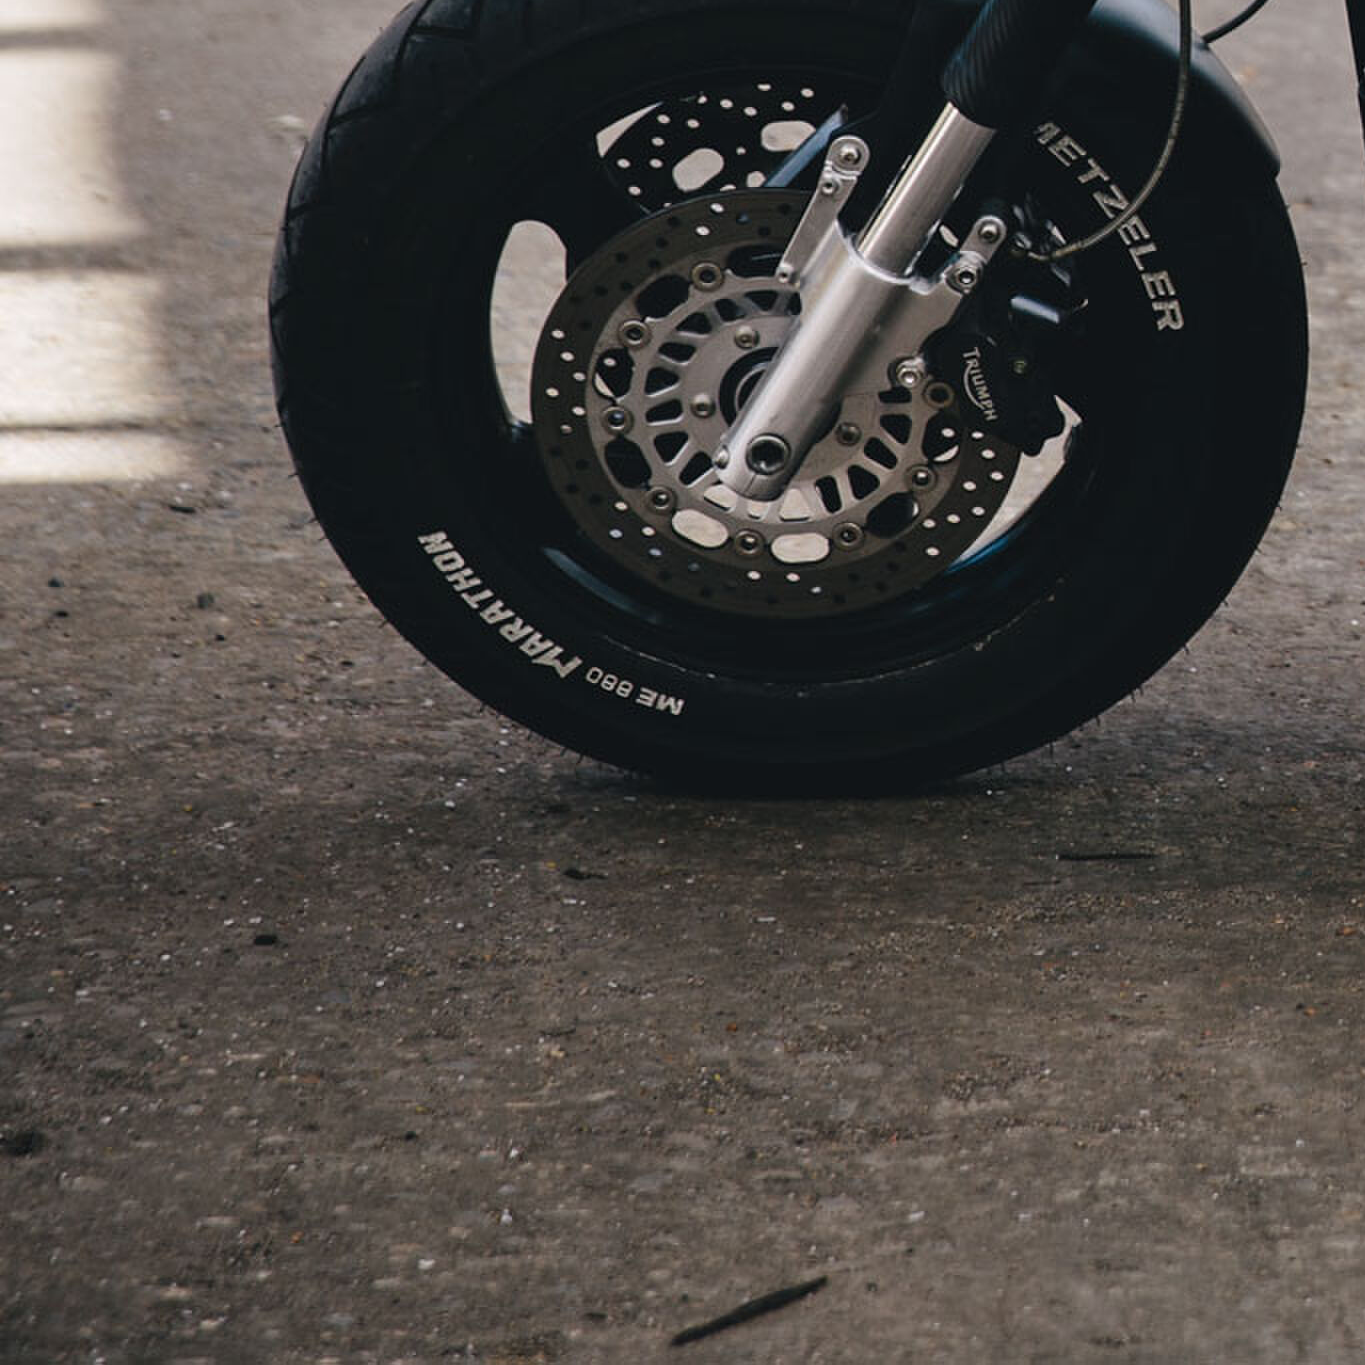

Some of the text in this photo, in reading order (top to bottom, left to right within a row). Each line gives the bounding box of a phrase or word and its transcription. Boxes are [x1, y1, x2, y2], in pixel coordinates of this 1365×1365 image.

[962, 346, 999, 422] TRIUMPH
[417, 531, 686, 717] ME 880 MARATHON
